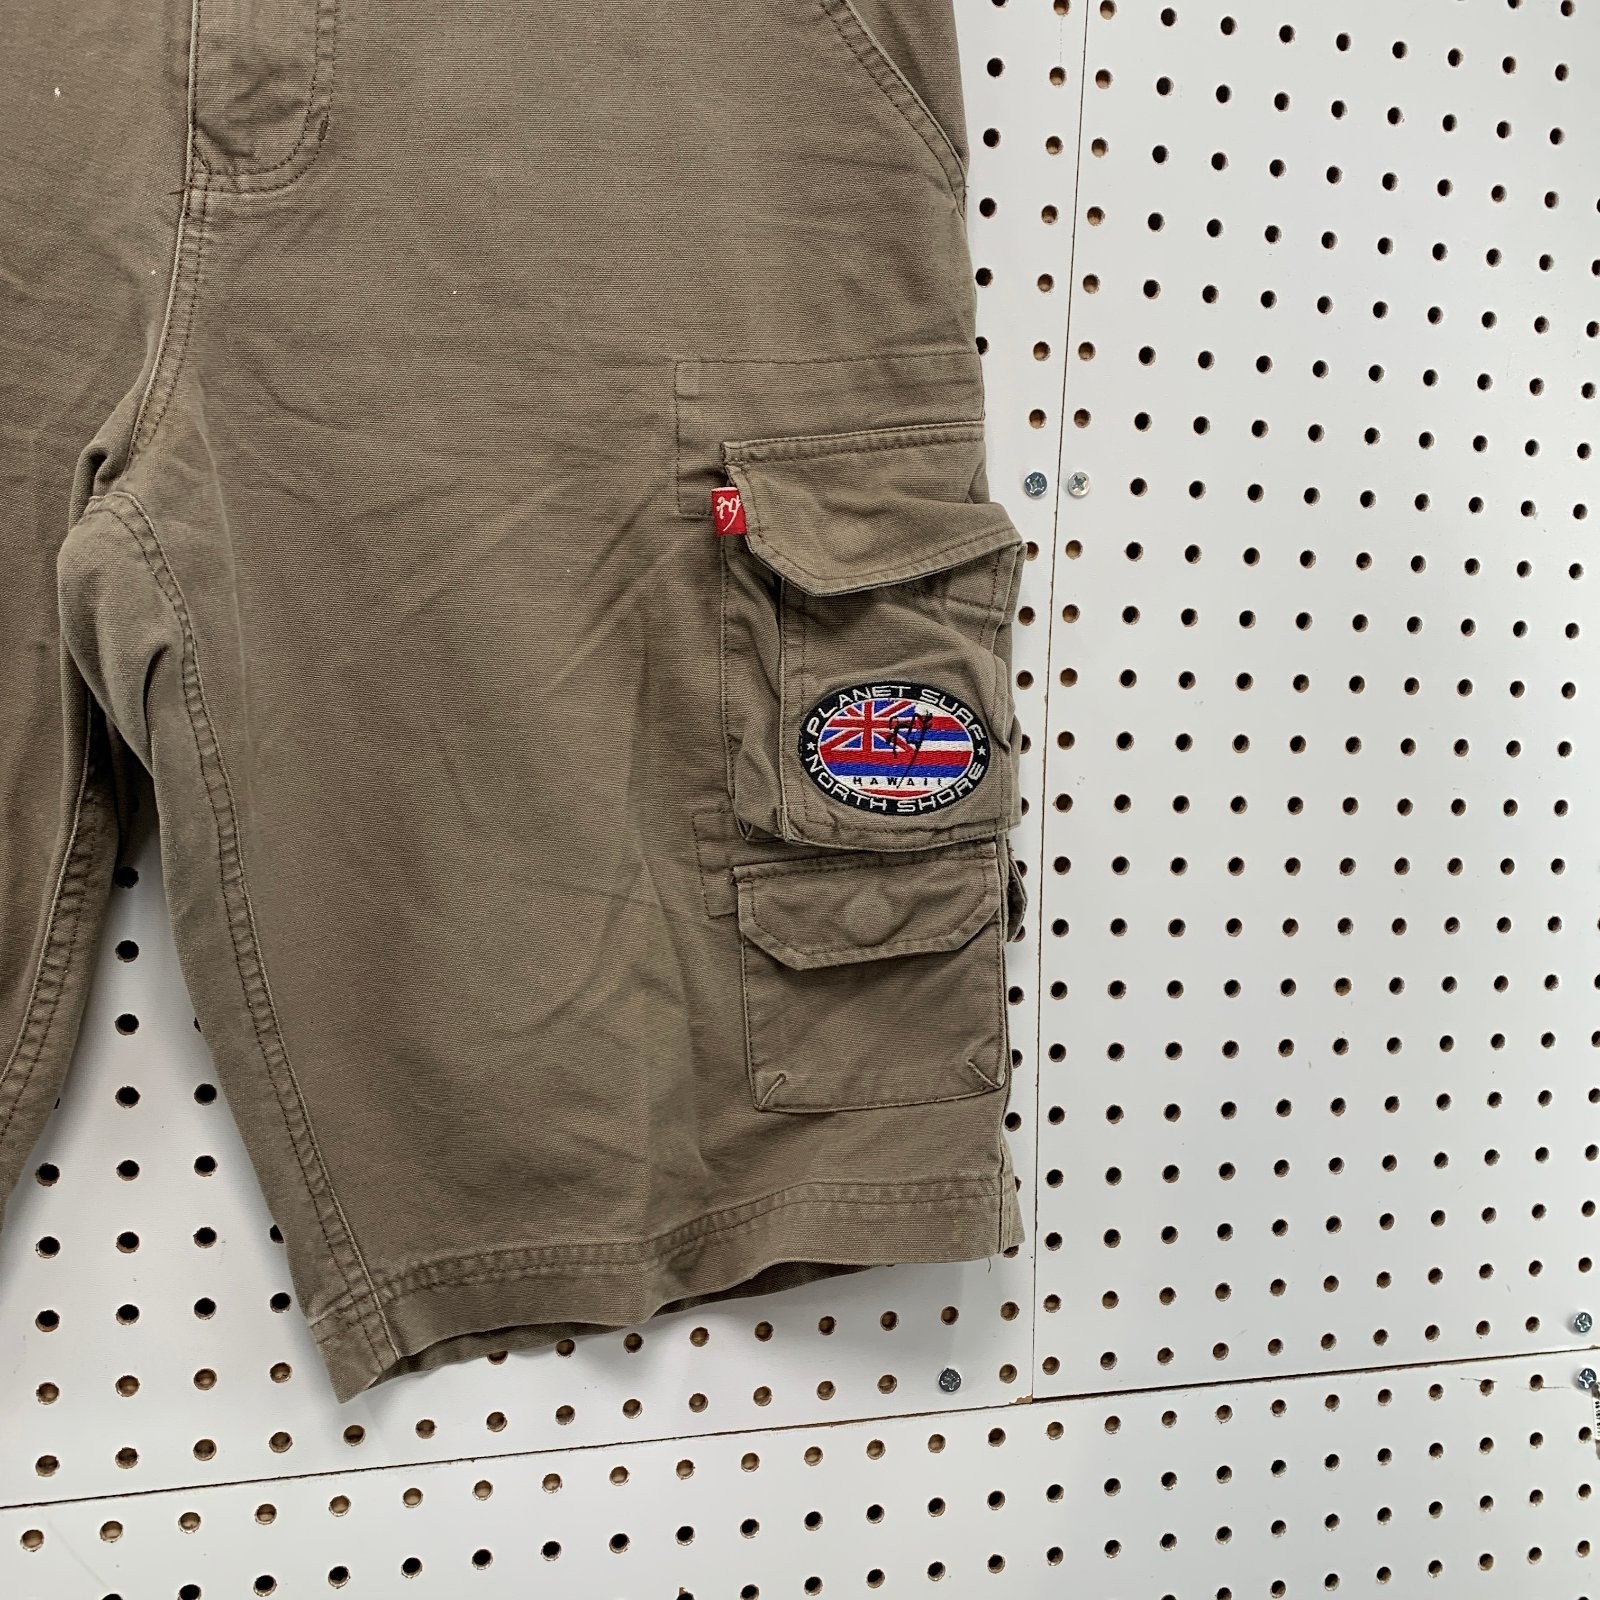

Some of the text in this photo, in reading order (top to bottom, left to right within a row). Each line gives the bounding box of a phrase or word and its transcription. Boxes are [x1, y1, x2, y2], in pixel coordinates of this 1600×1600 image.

[806, 685, 987, 741] PLANET SURF
[805, 753, 985, 813] NORTH SHORE
[853, 776, 942, 787] HAWAII
